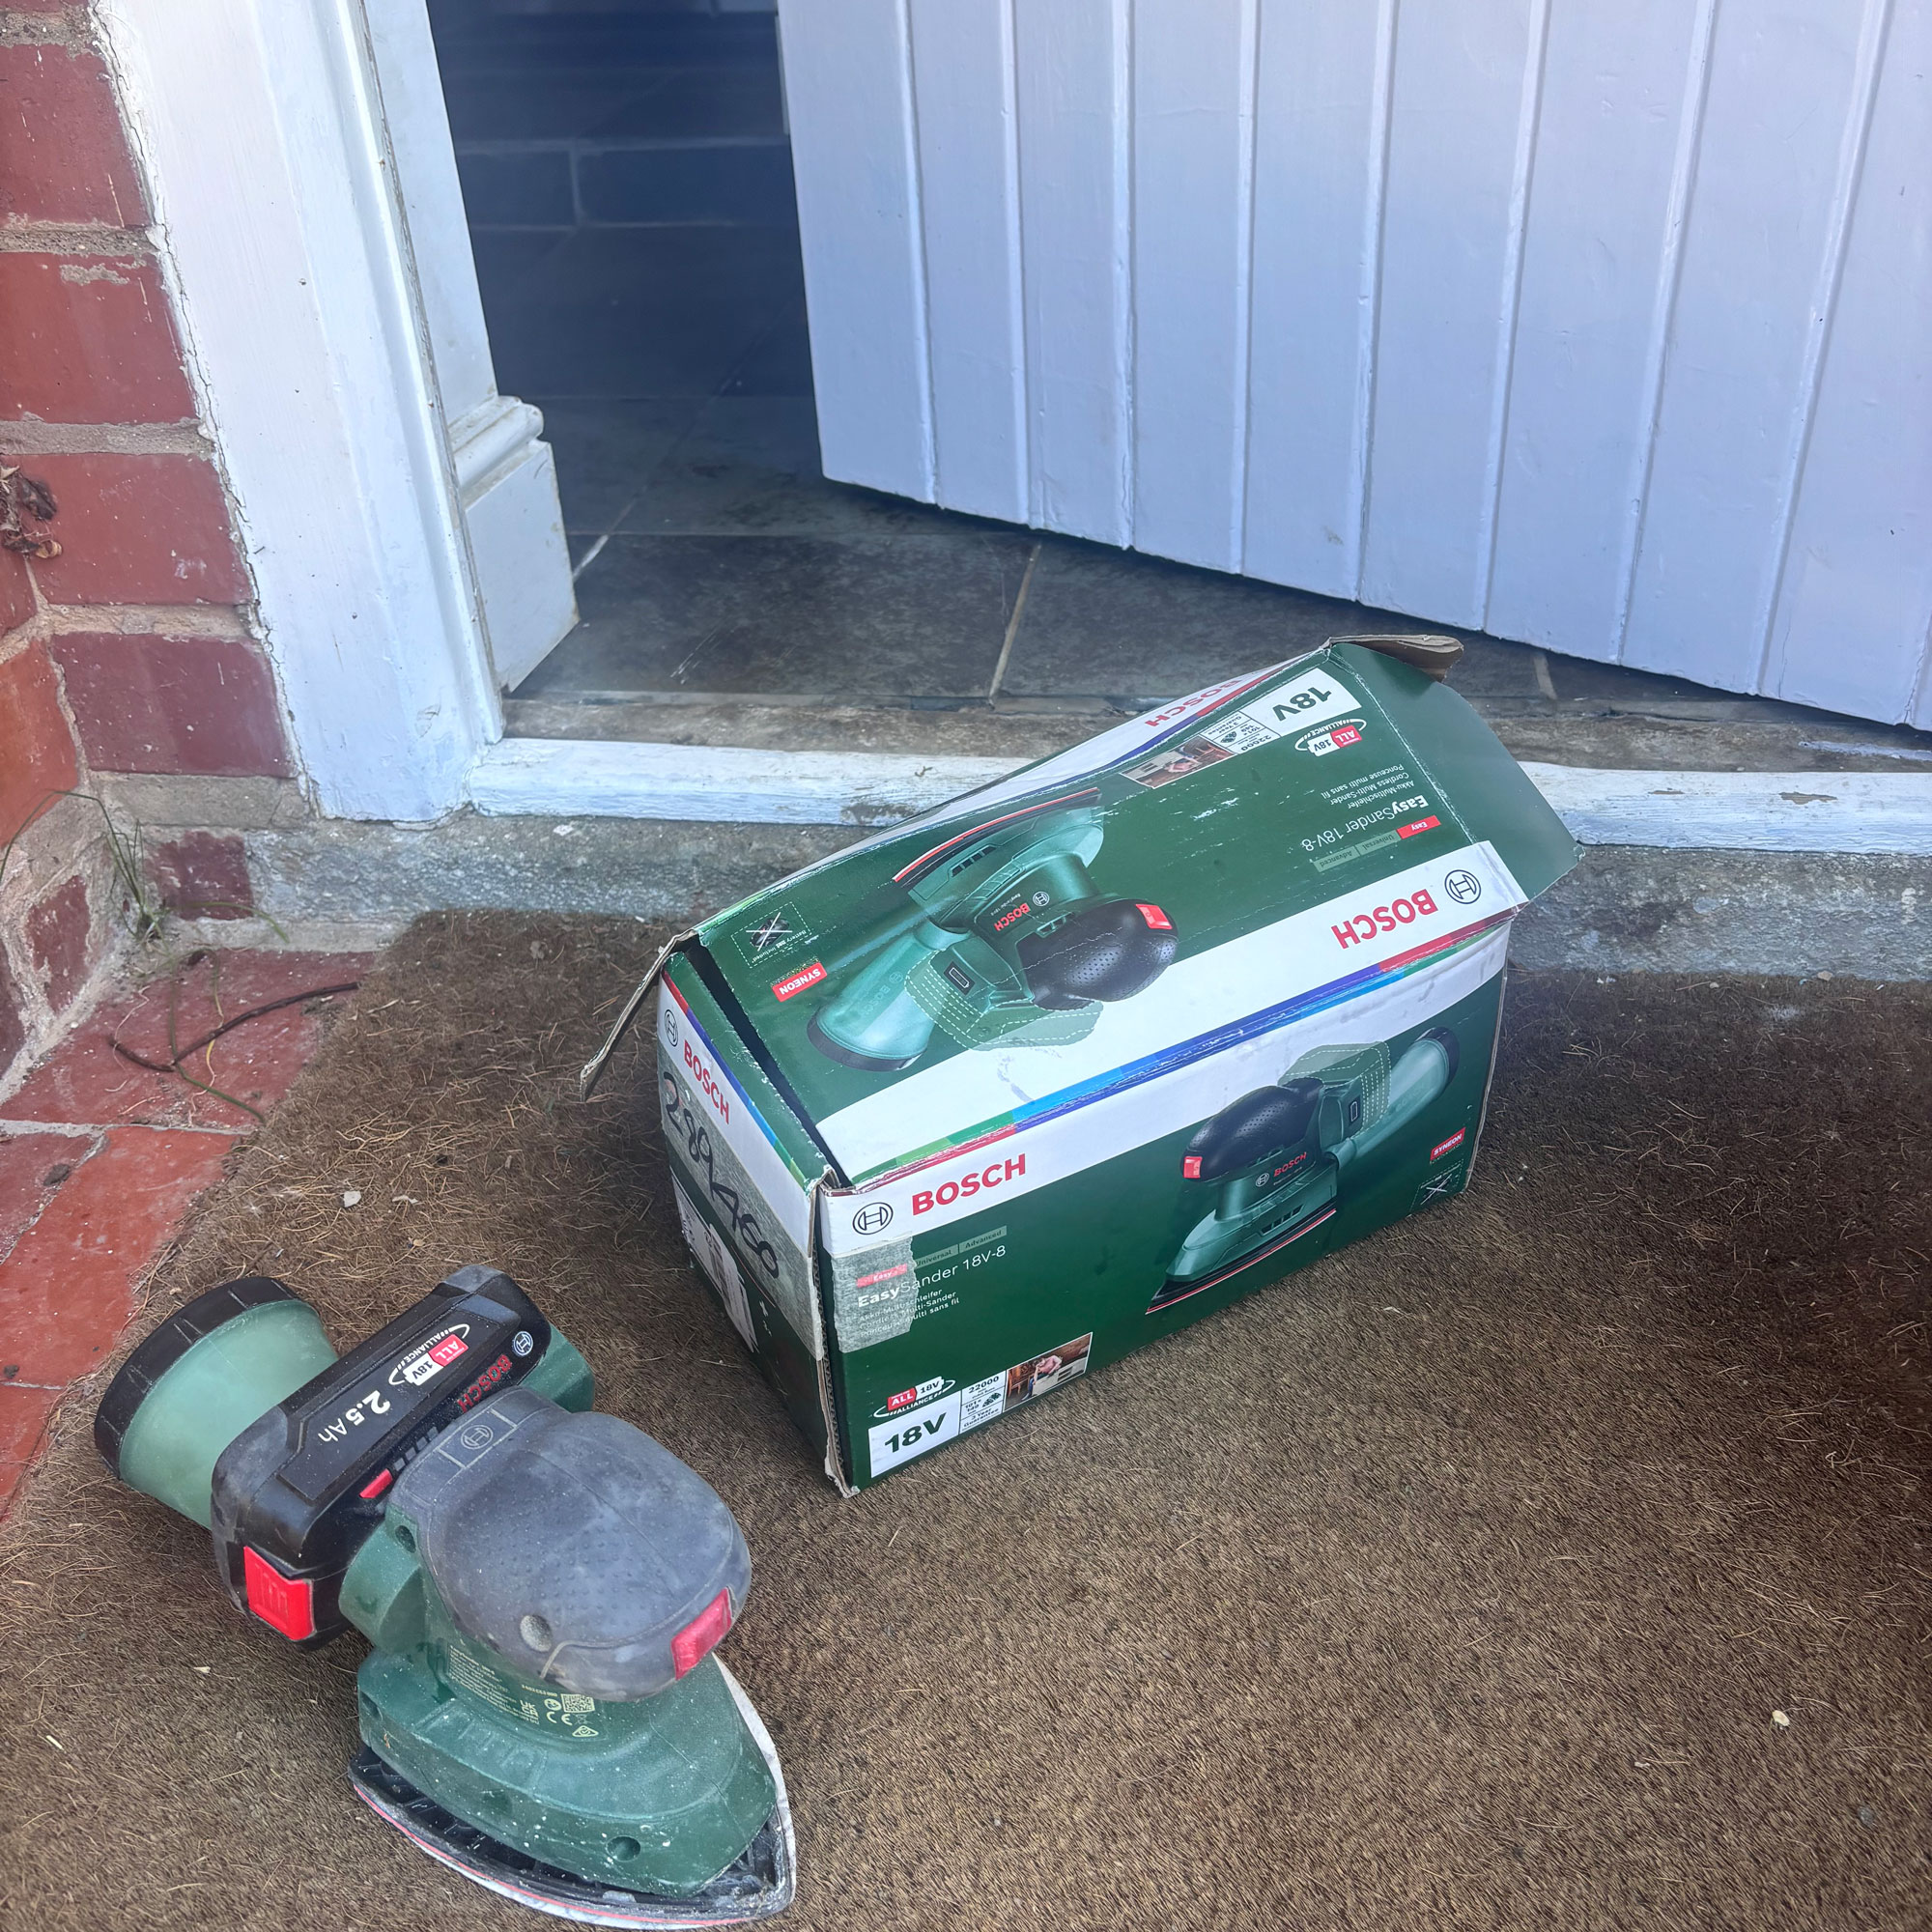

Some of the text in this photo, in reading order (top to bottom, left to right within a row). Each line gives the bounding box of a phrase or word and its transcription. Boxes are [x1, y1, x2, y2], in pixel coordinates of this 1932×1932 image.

[1145, 679, 1242, 726] BOSCH
[1272, 687, 1332, 722] 18V
[1309, 719, 1343, 736] ALLIANCE
[1335, 729, 1355, 743] ALL
[1240, 734, 1272, 752] 22000
[1314, 739, 1332, 752] 18V
[1321, 764, 1405, 800] Ponceuse multi sans fil
[1330, 772, 1409, 806] Cordless Multi-Sander
[1348, 780, 1415, 810] Akku-Multischleifer
[1301, 794, 1429, 852] EasySander 18V-8
[1410, 821, 1428, 831] Easy
[1362, 834, 1395, 850] Universal
[1320, 850, 1353, 867] Advanced
[994, 902, 1031, 932] BOSCH
[1330, 889, 1438, 950] BOSCH
[779, 968, 821, 995] SYNEON
[684, 1039, 729, 1125] BOSCH
[1434, 1133, 1463, 1155] SYNEON
[1273, 1151, 1307, 1178] BOSCH
[912, 1152, 1026, 1216] BOSCH
[965, 1230, 1003, 1249] Advanced
[858, 1245, 1007, 1308] EasySander 18V-8
[930, 1303, 949, 1314] sans
[951, 1297, 960, 1306] fil
[403, 1332, 441, 1363] ALLIANCE
[435, 1340, 459, 1359] ALL
[412, 1360, 434, 1379] 18V
[456, 1353, 513, 1414] BOSCH
[892, 1392, 914, 1406] ALL
[920, 1380, 940, 1394] 18V
[968, 1376, 1000, 1394] 22000
[317, 1389, 391, 1442] 2.5 Ah
[896, 1395, 934, 1413] ALLIANCE
[884, 1412, 947, 1453] 18V
